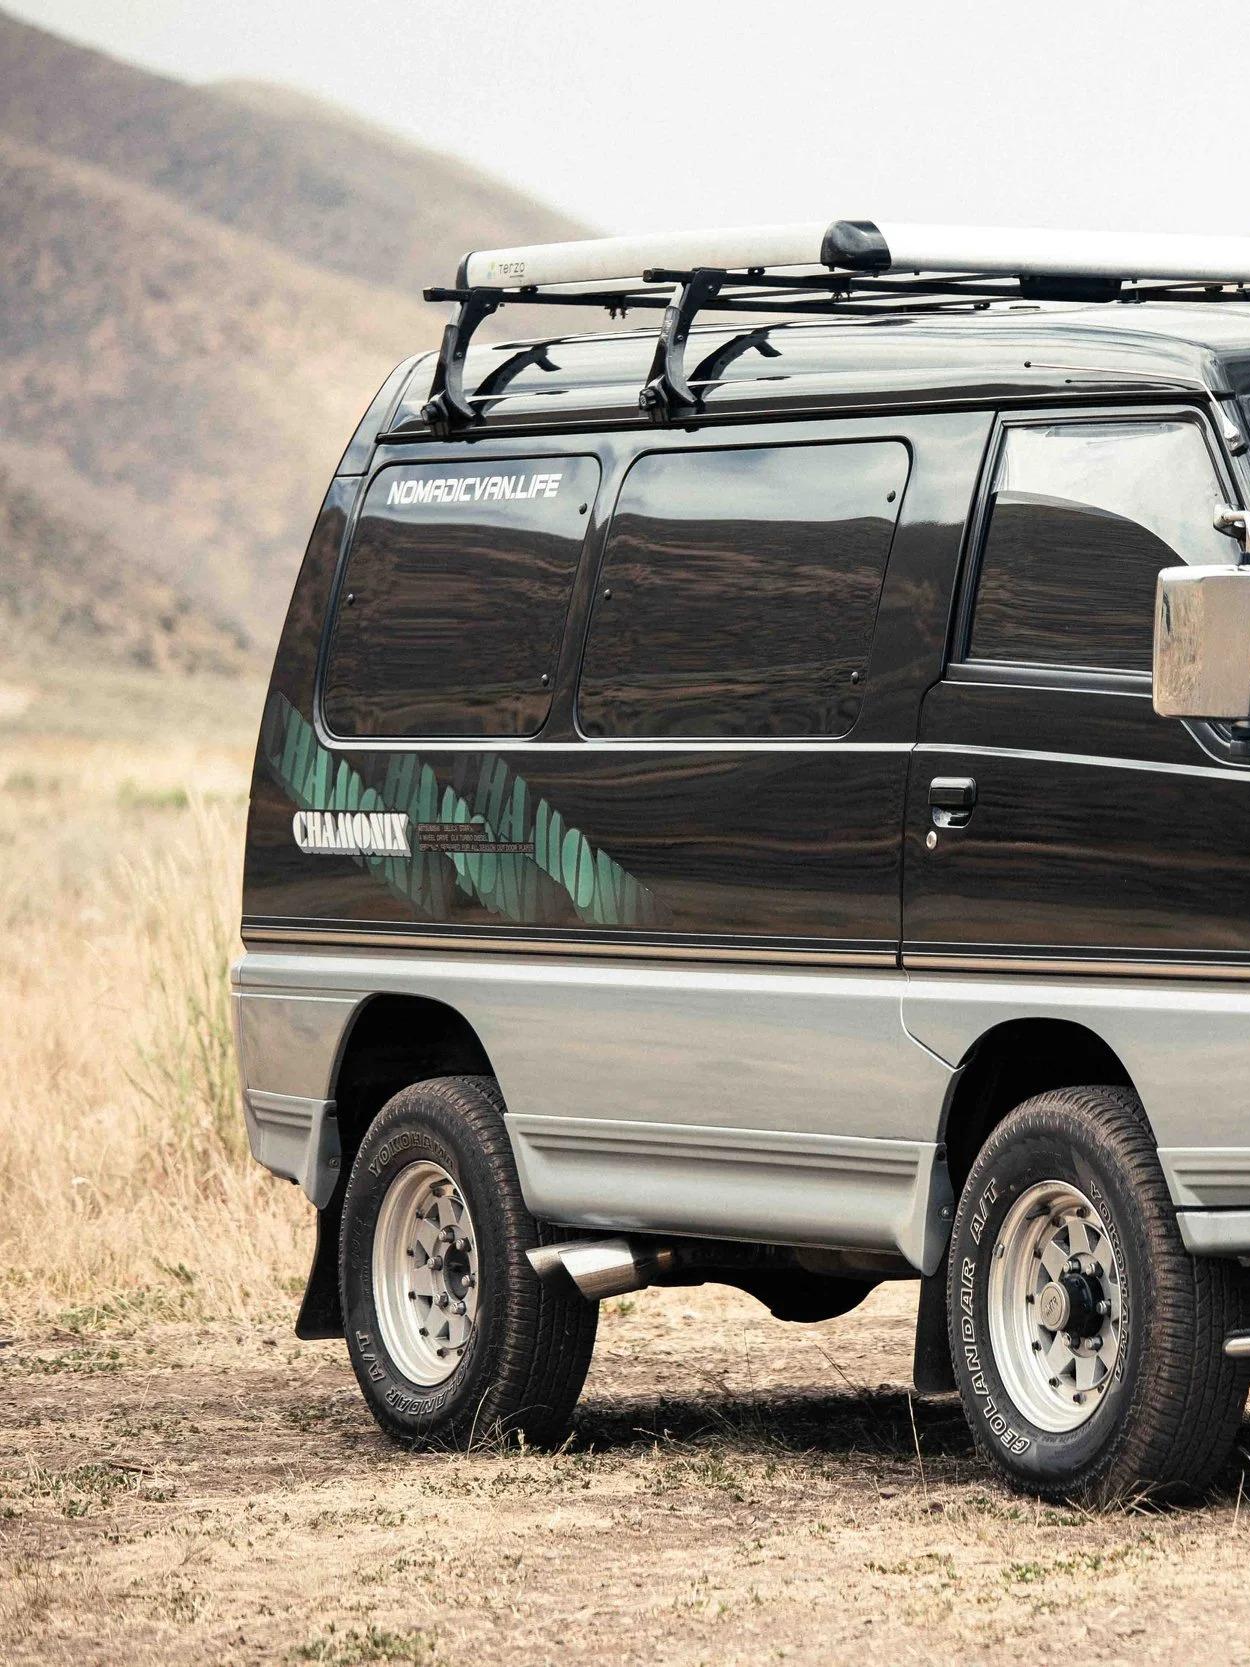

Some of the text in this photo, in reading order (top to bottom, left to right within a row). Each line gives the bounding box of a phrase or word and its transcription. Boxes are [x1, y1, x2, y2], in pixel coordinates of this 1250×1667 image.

[387, 473, 563, 505] NOMADICVAN.LIFE
[292, 811, 411, 857] CHAMONIX
[368, 1131, 454, 1178] YOKOHAMA
[969, 1178, 1000, 1247] A/T
[1090, 1180, 1132, 1383] YOKOHAMA
[954, 1256, 1032, 1456] GEOLANDAR
